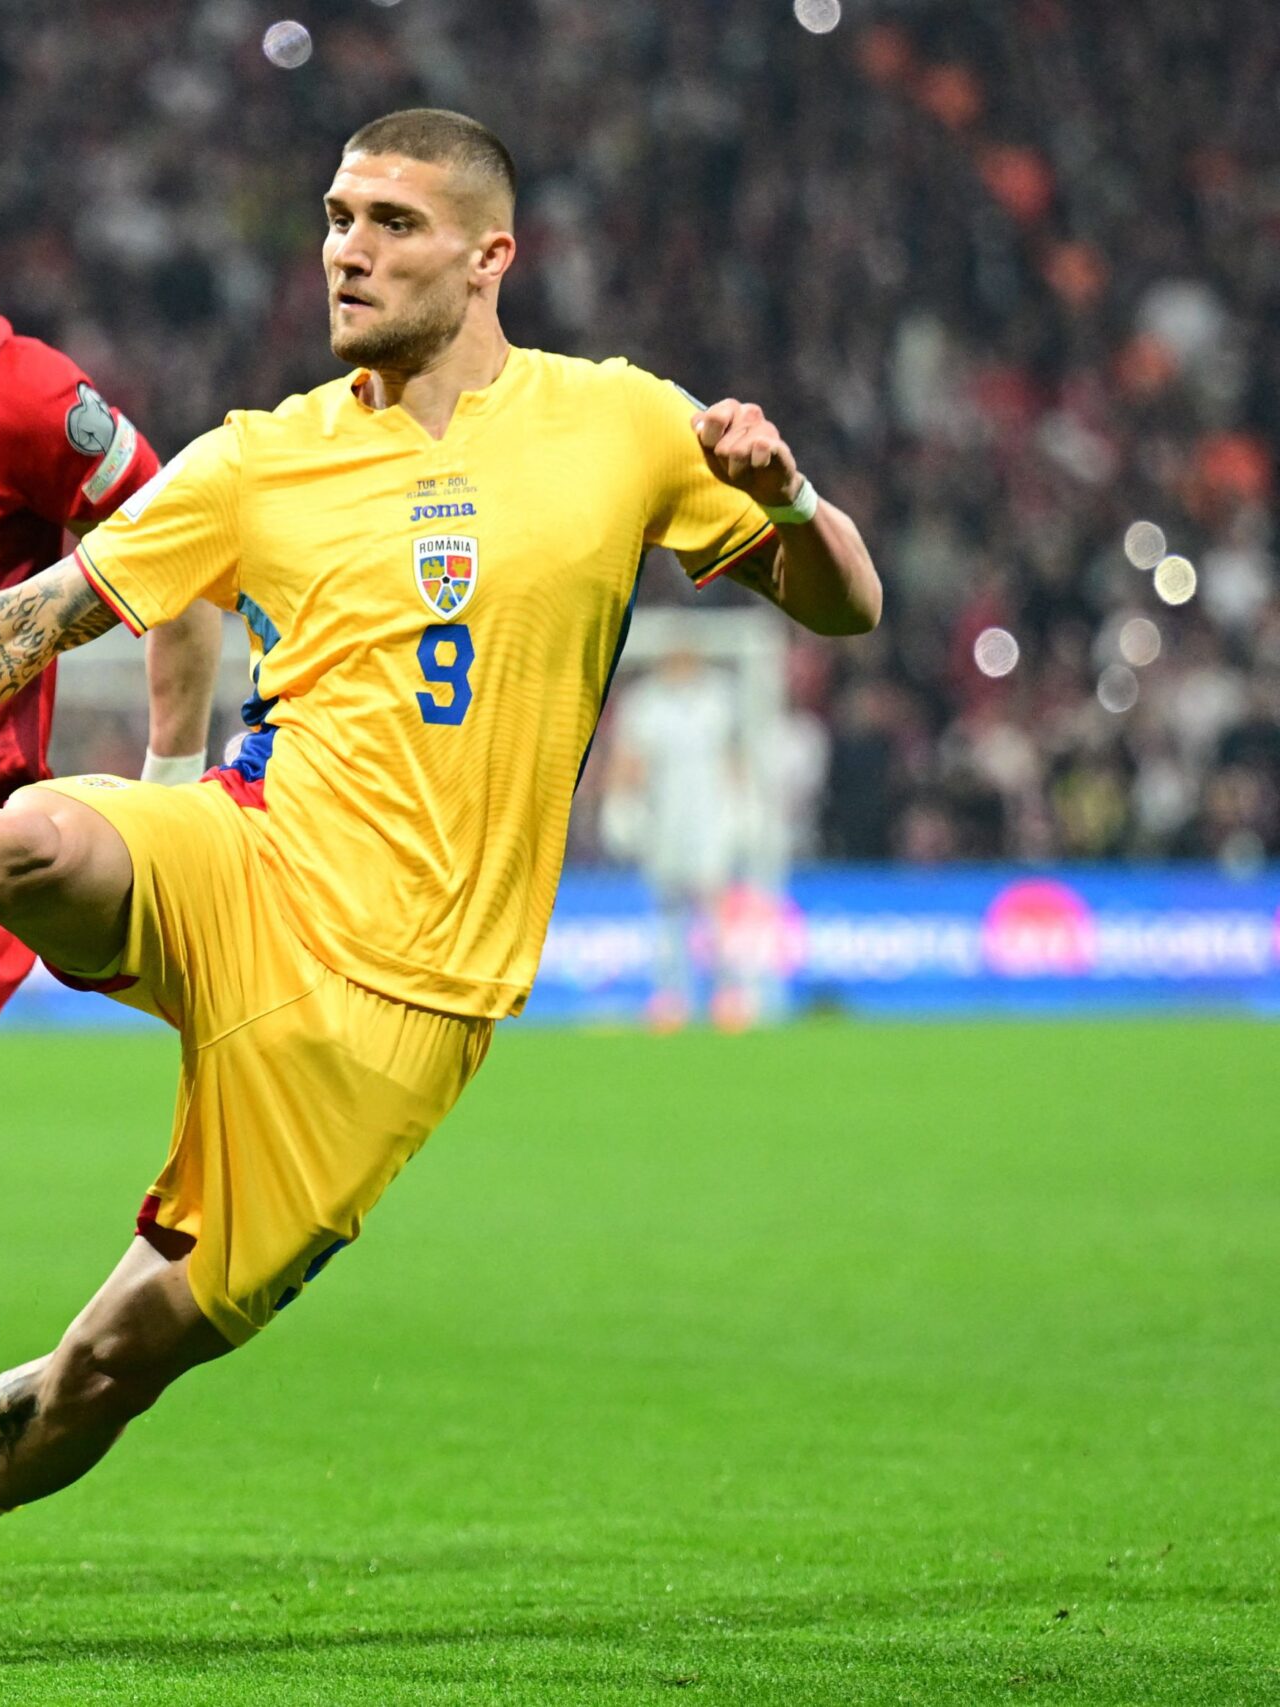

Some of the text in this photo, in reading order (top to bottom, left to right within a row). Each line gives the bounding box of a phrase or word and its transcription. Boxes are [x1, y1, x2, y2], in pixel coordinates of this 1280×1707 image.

[416, 479, 436, 490] TUR
[448, 477, 468, 487] ROU
[419, 536, 472, 554] ROMÂNIA
[415, 623, 476, 727] 9
